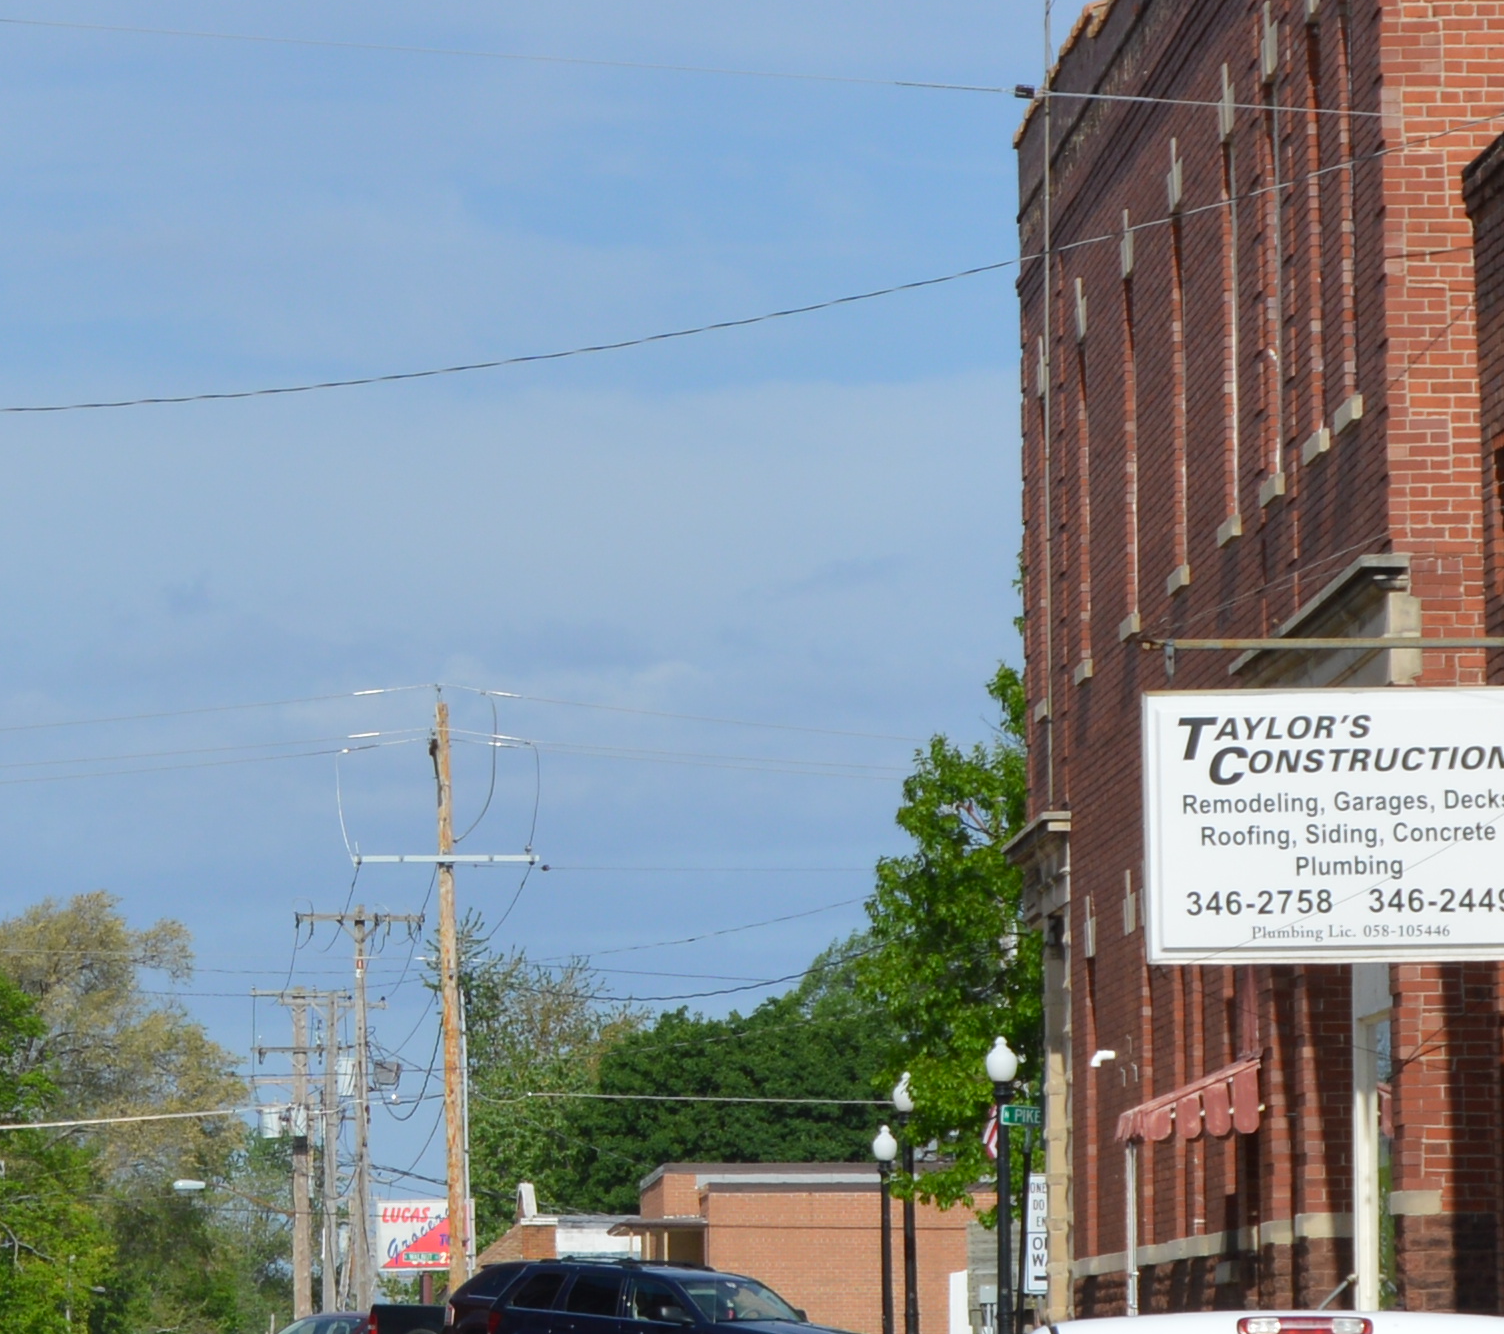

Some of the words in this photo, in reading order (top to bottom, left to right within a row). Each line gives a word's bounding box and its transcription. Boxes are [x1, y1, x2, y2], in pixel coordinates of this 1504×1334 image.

[1176, 714, 1372, 762] TAYLOR'S
[1182, 793, 1327, 817] Remodeling,
[1333, 790, 1437, 816] Garages,
[1200, 825, 1298, 849] Roofing,
[1305, 824, 1385, 847] Siding,
[1392, 821, 1497, 844] Concrete
[1295, 856, 1405, 880] Plumbing
[1185, 889, 1334, 917] 346-2758
[1251, 925, 1325, 942] Plumbing
[1327, 924, 1357, 938] Lic.
[1362, 923, 1451, 938] 058-105446
[1014, 1108, 1041, 1124] PIKE
[382, 1207, 430, 1223] LUCAS
[1033, 1199, 1045, 1211] DO
